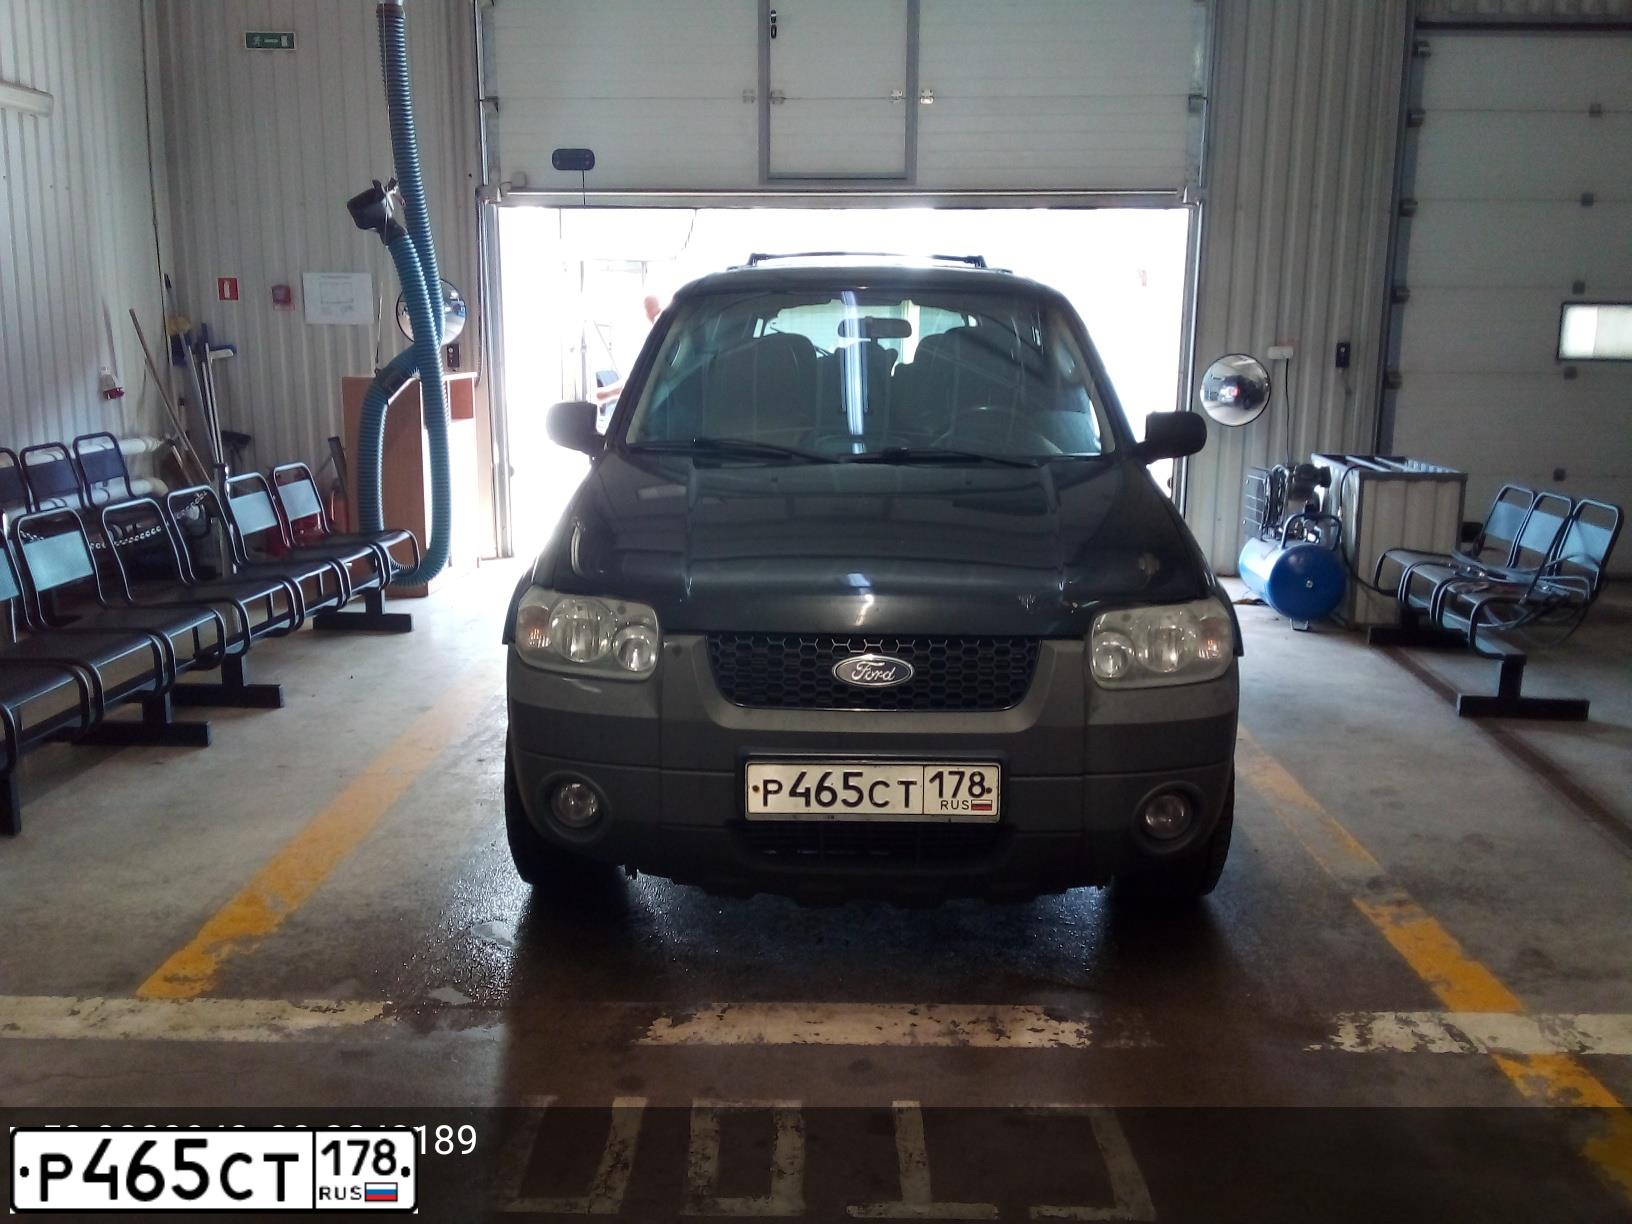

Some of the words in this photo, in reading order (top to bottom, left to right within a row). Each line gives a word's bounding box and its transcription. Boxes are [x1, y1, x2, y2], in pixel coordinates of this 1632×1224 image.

[851, 661, 896, 681] Ford
[928, 770, 986, 799] 178
[940, 799, 970, 811] RUS
